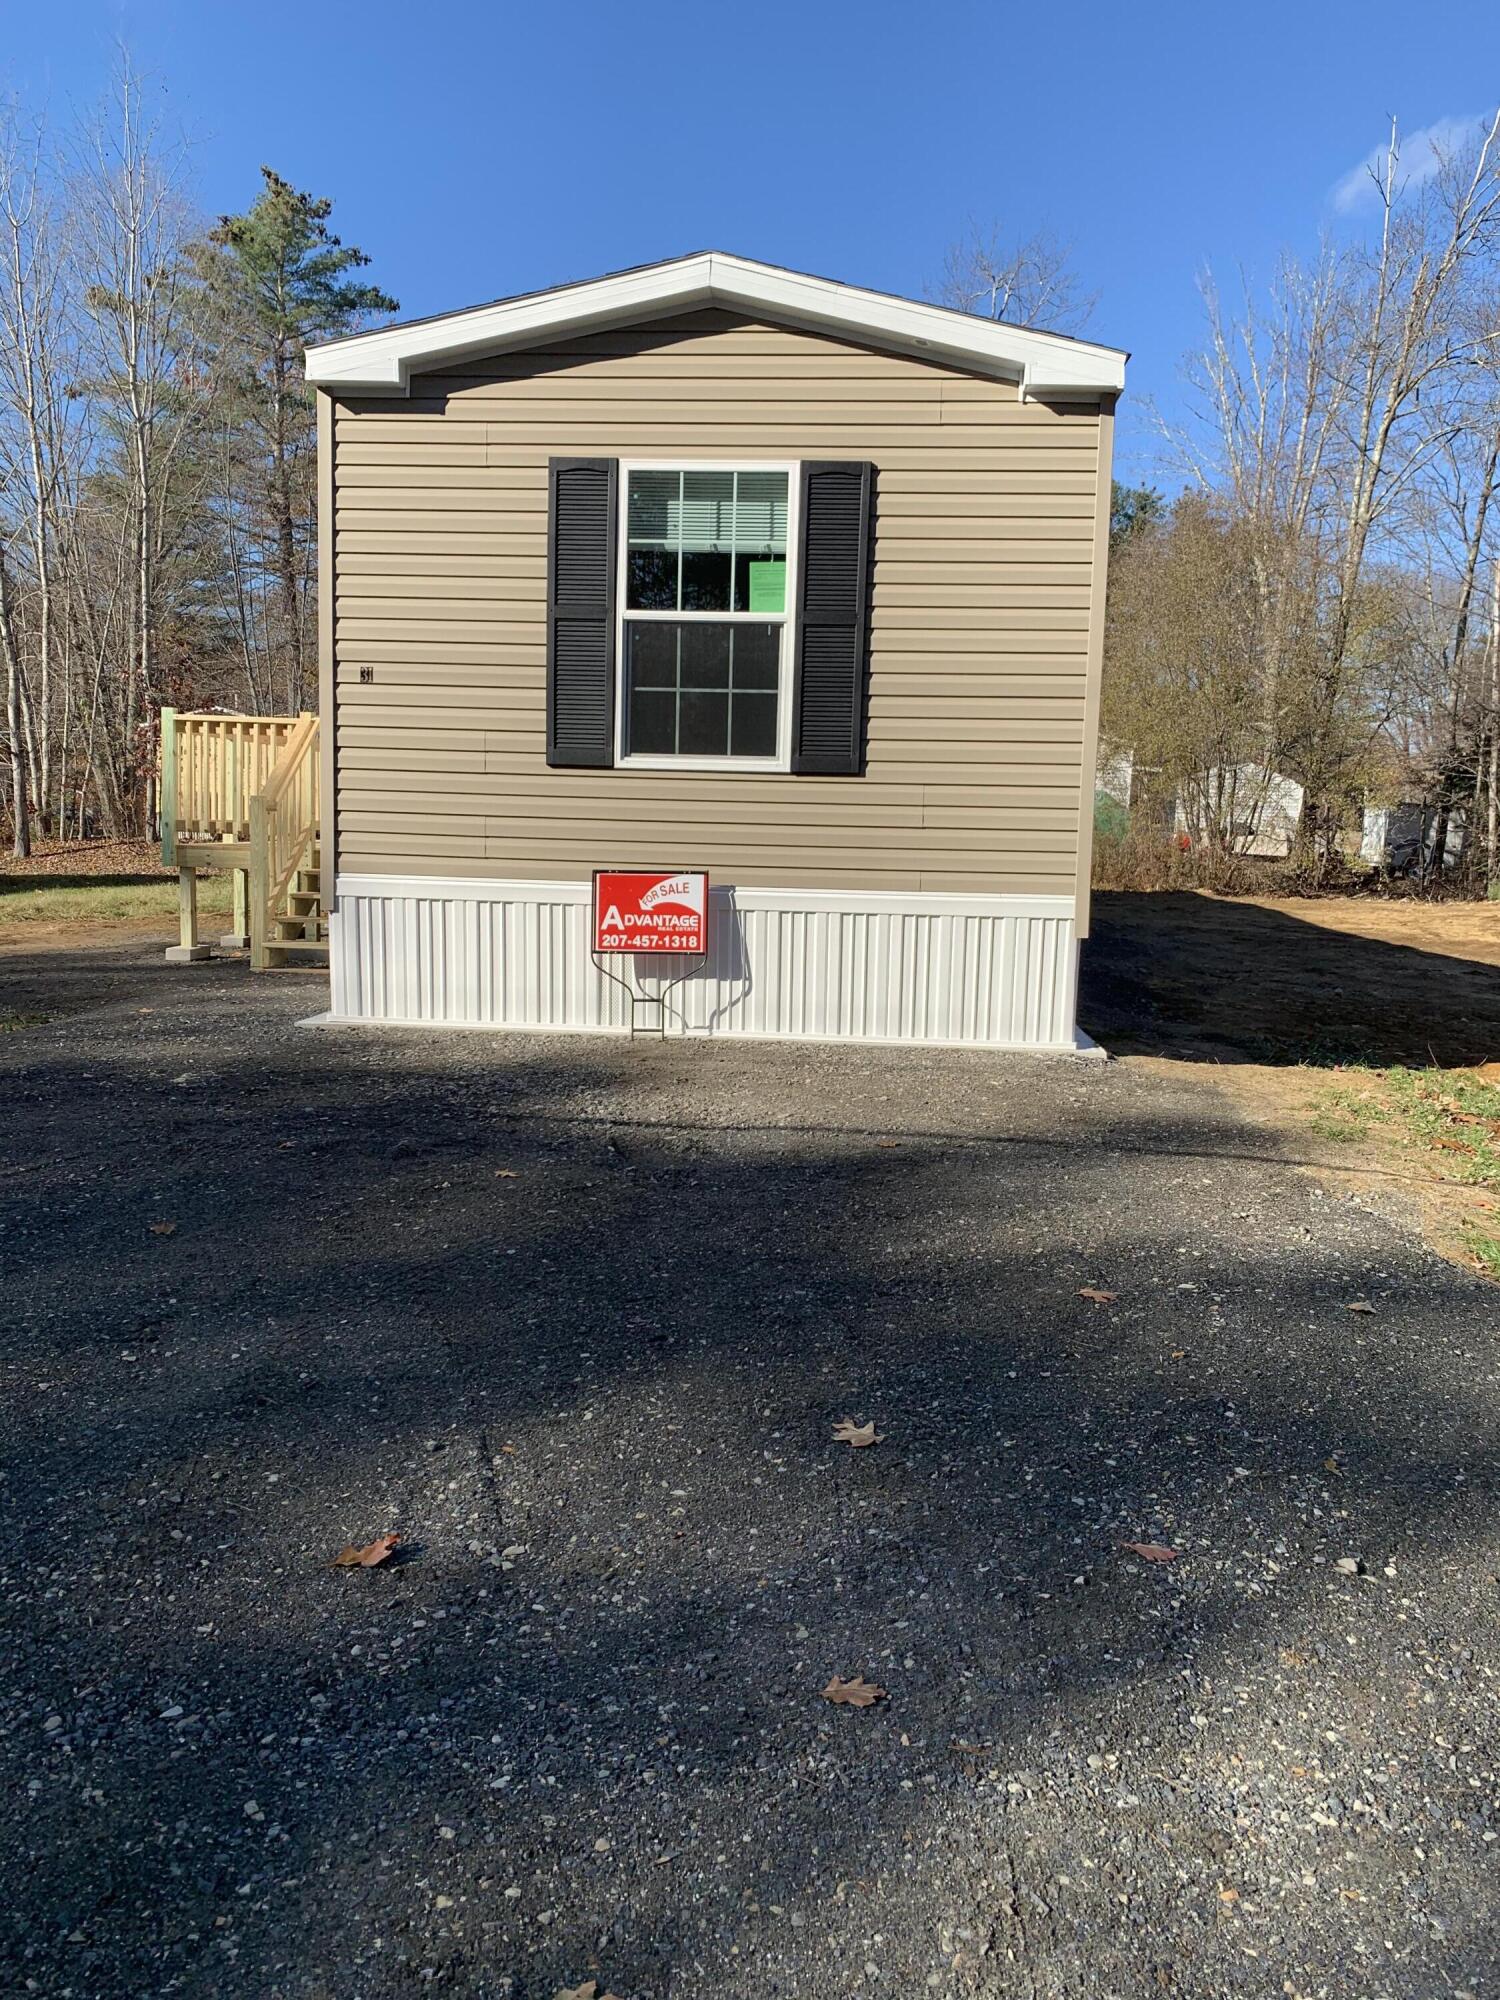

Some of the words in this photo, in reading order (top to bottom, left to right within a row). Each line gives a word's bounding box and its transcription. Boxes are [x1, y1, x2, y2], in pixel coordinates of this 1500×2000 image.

[360, 667, 373, 683] 31
[642, 889, 659, 906] FOR
[660, 882, 690, 897] SALE
[601, 905, 699, 930] ADVANTAGE
[602, 934, 698, 948] 207-457-1318
